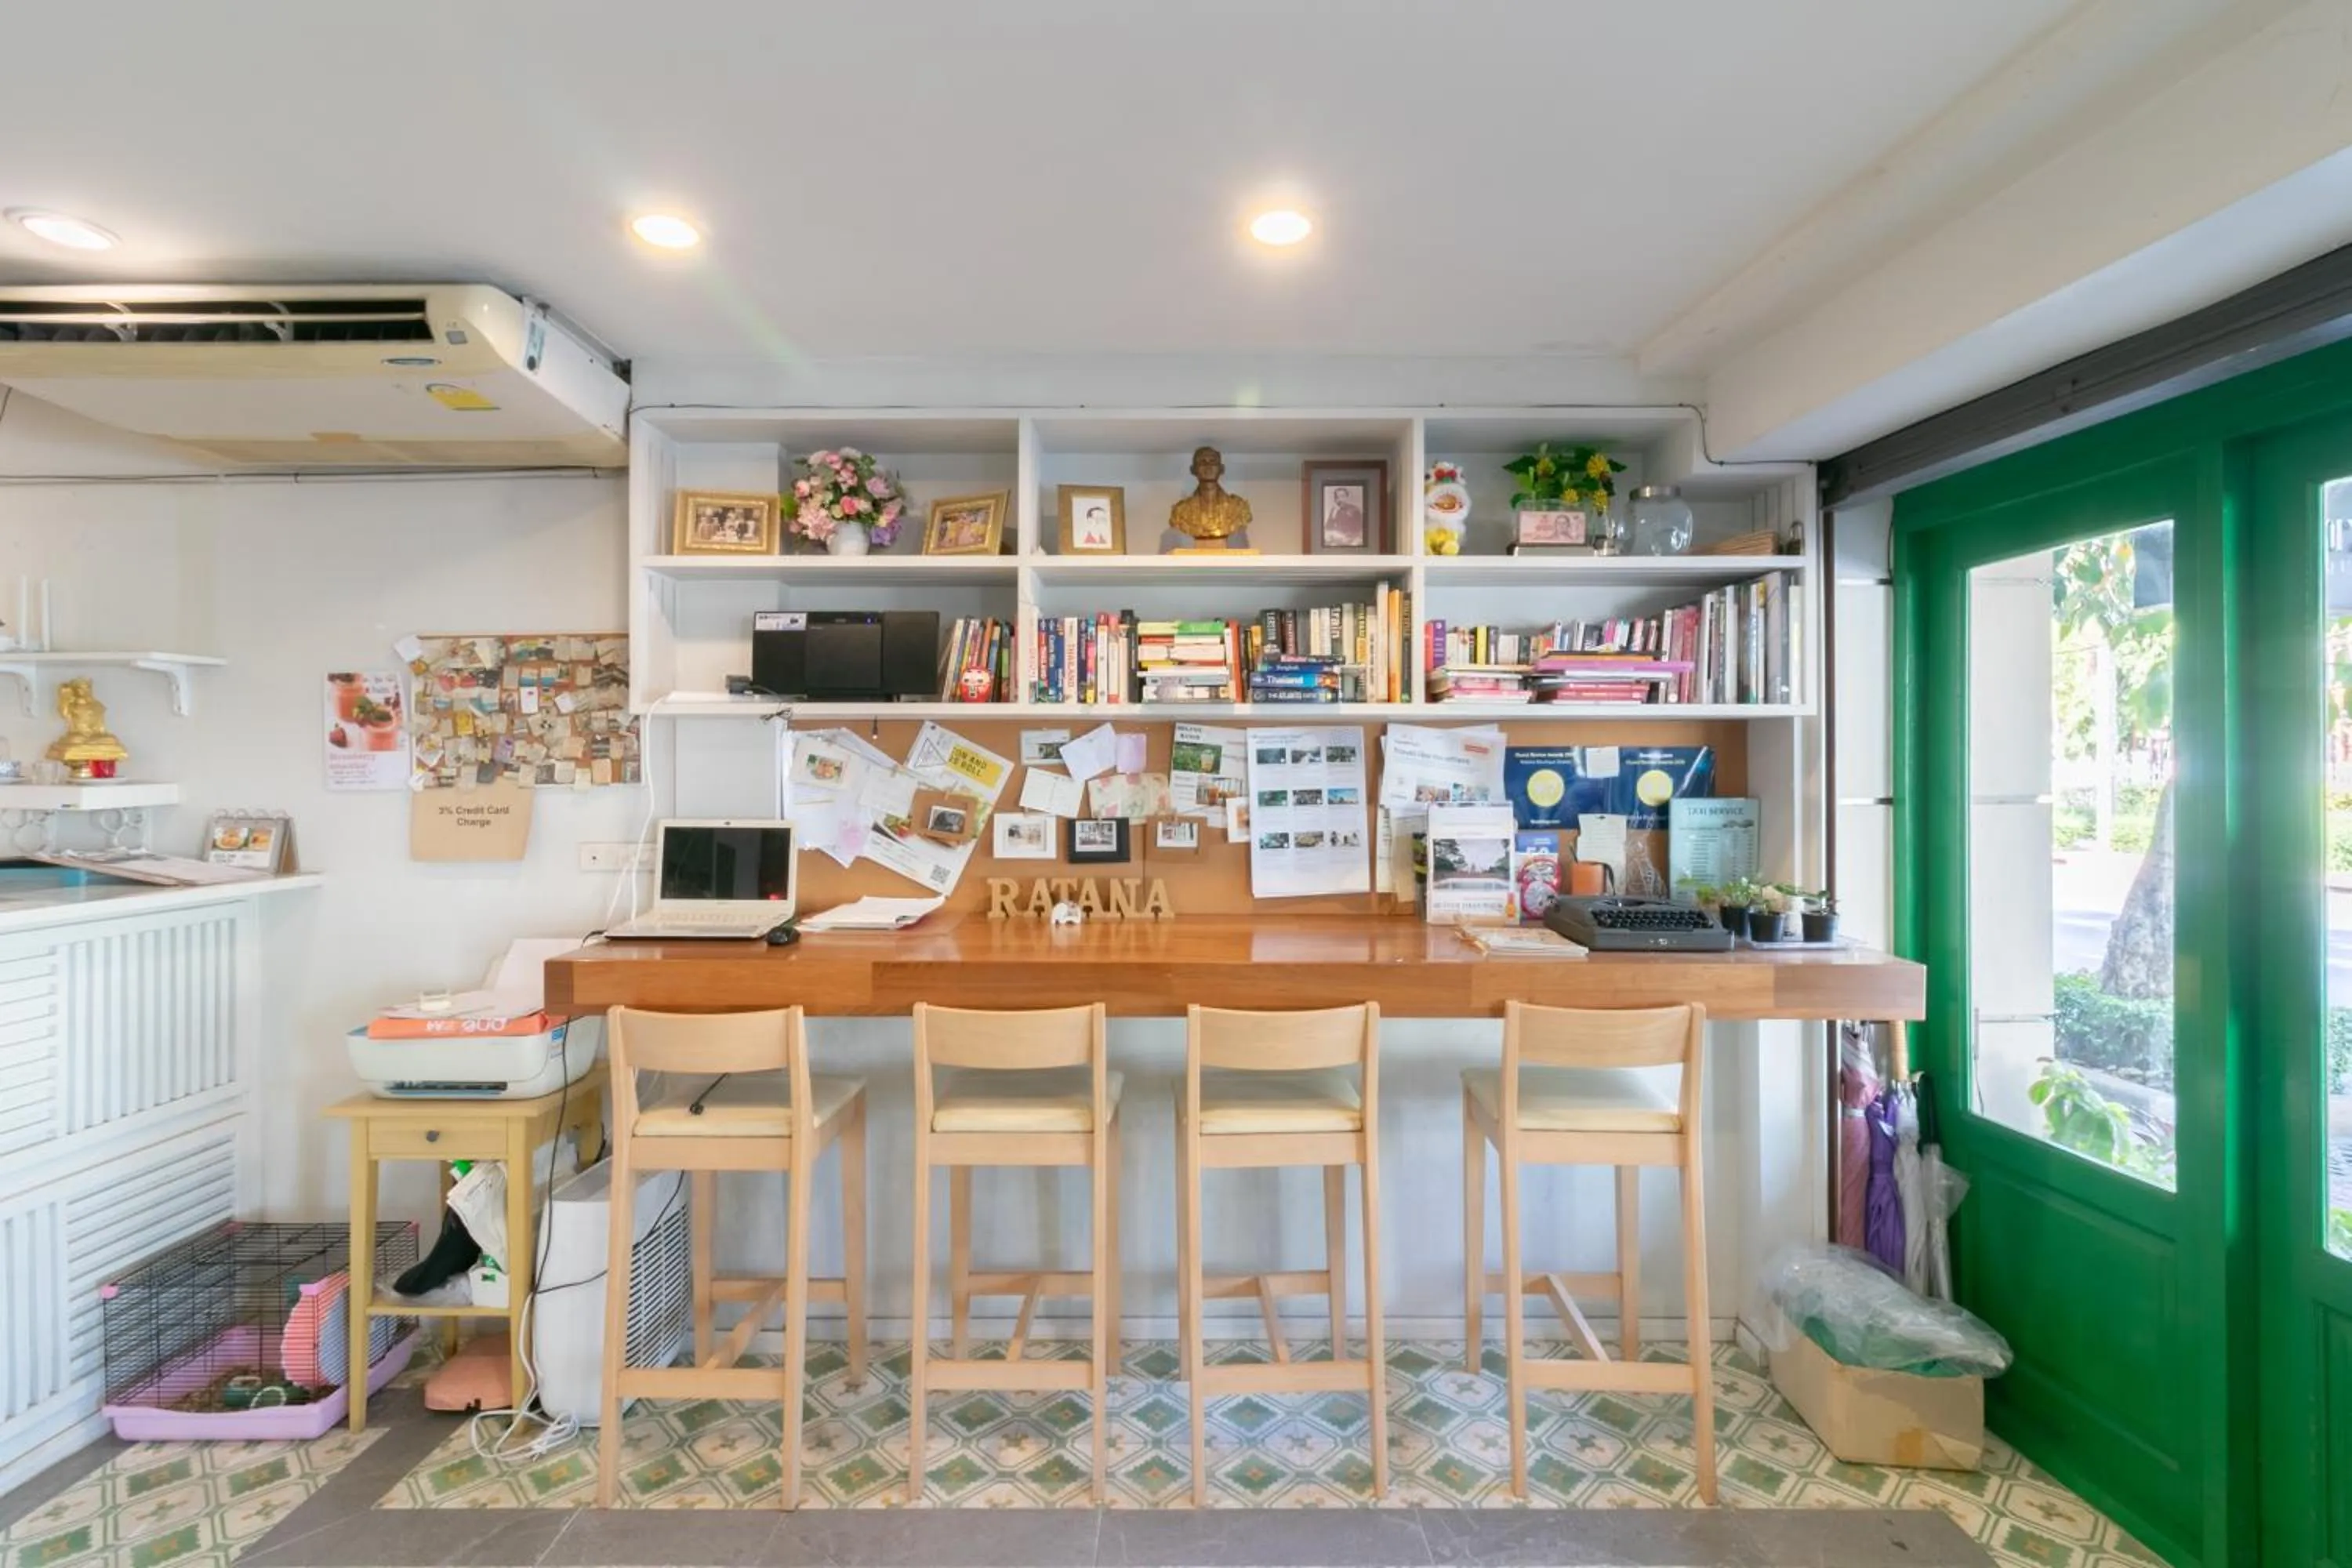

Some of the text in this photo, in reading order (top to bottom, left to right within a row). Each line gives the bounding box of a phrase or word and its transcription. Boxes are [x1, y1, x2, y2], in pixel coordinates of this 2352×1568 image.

[456, 806, 485, 815] Credit
[487, 805, 510, 815] Card
[1687, 807, 1744, 816] TAXI SERVICE
[456, 817, 492, 829] Charge
[987, 877, 1174, 918] RATANA
